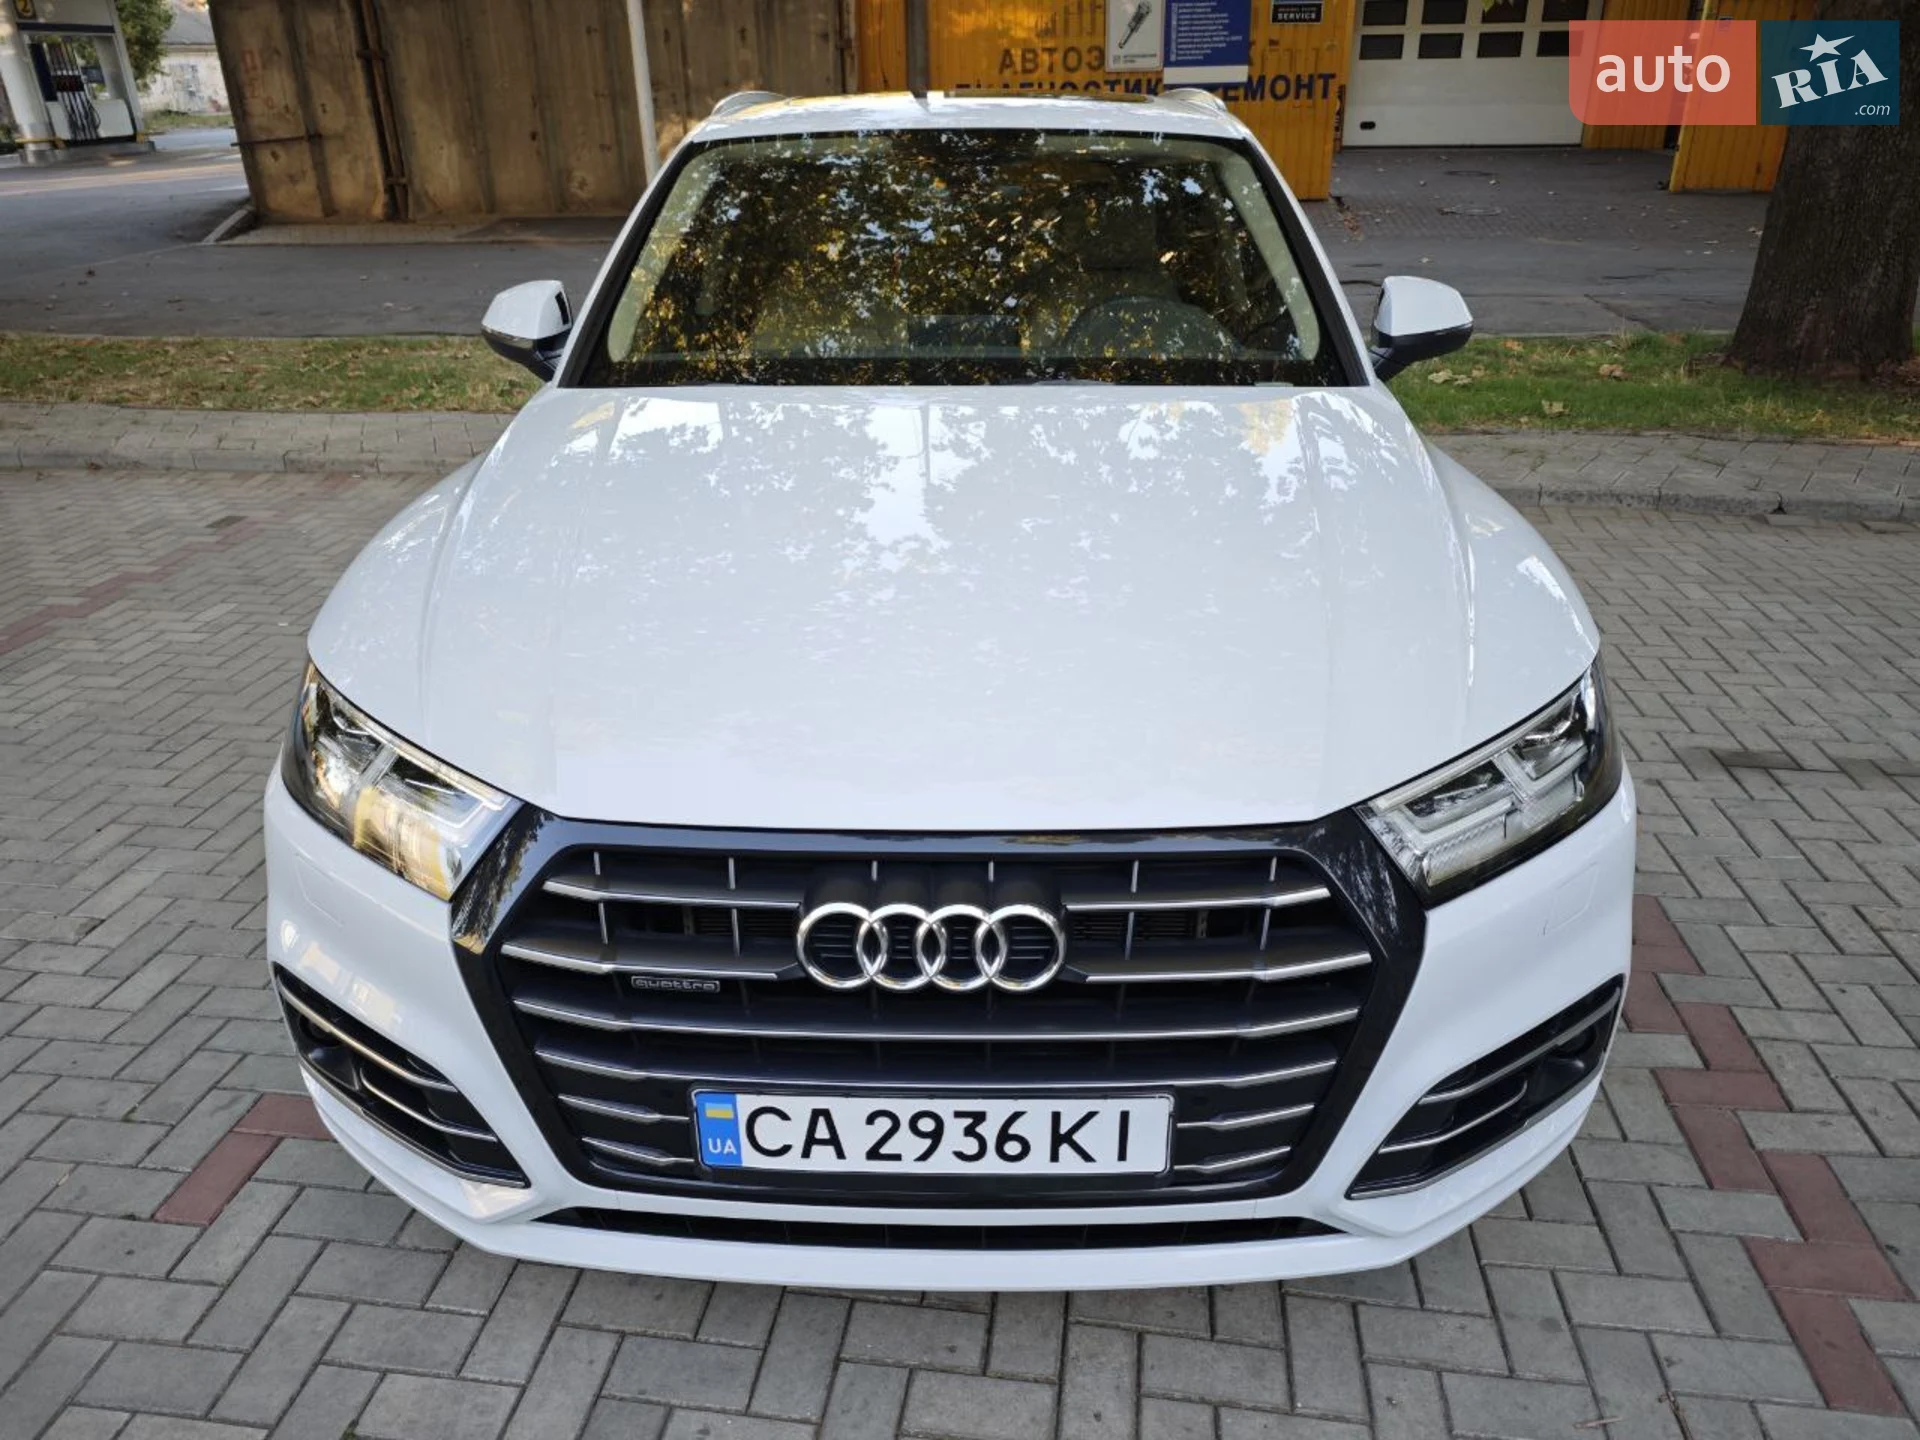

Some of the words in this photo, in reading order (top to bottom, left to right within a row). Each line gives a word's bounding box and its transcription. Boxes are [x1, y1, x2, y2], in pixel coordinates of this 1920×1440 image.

[1278, 12, 1316, 20] SERVICE
[634, 978, 716, 990] quattro
[745, 1106, 847, 1160] CA
[865, 1109, 1031, 1162] 2936
[1049, 1110, 1130, 1163] KI
[708, 1138, 737, 1155] UA
